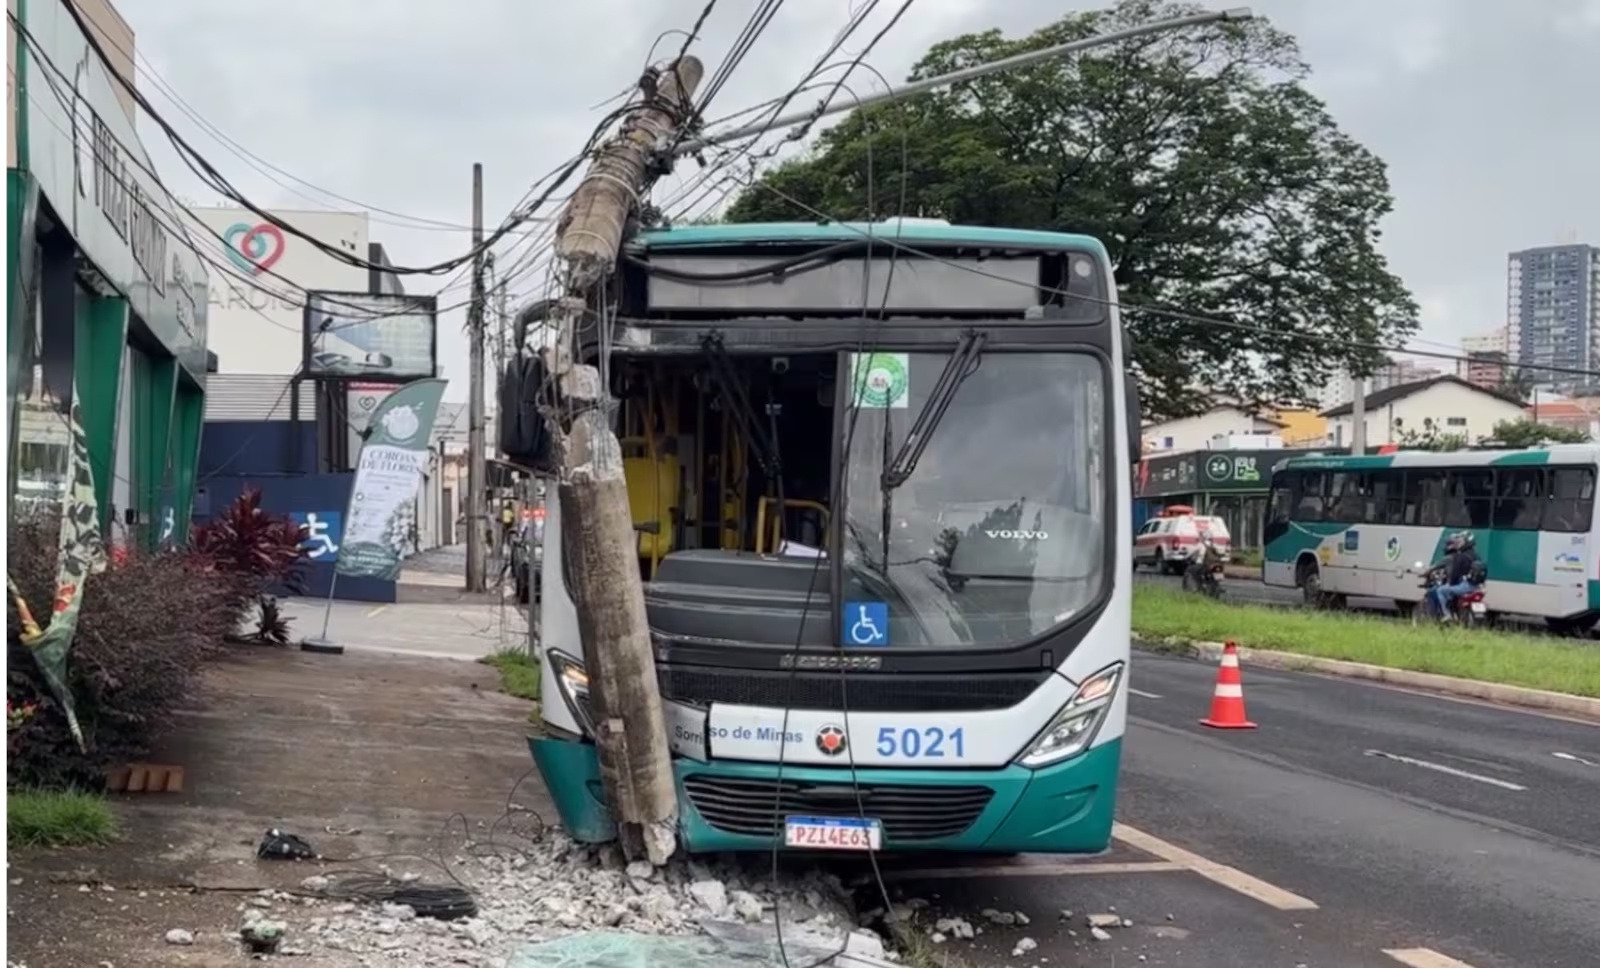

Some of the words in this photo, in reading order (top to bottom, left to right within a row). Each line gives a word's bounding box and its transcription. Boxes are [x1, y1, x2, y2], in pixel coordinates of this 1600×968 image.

[985, 529, 1048, 540] VOLVO
[732, 727, 752, 739] de
[757, 727, 804, 743] Minas
[877, 727, 964, 757] 5021
